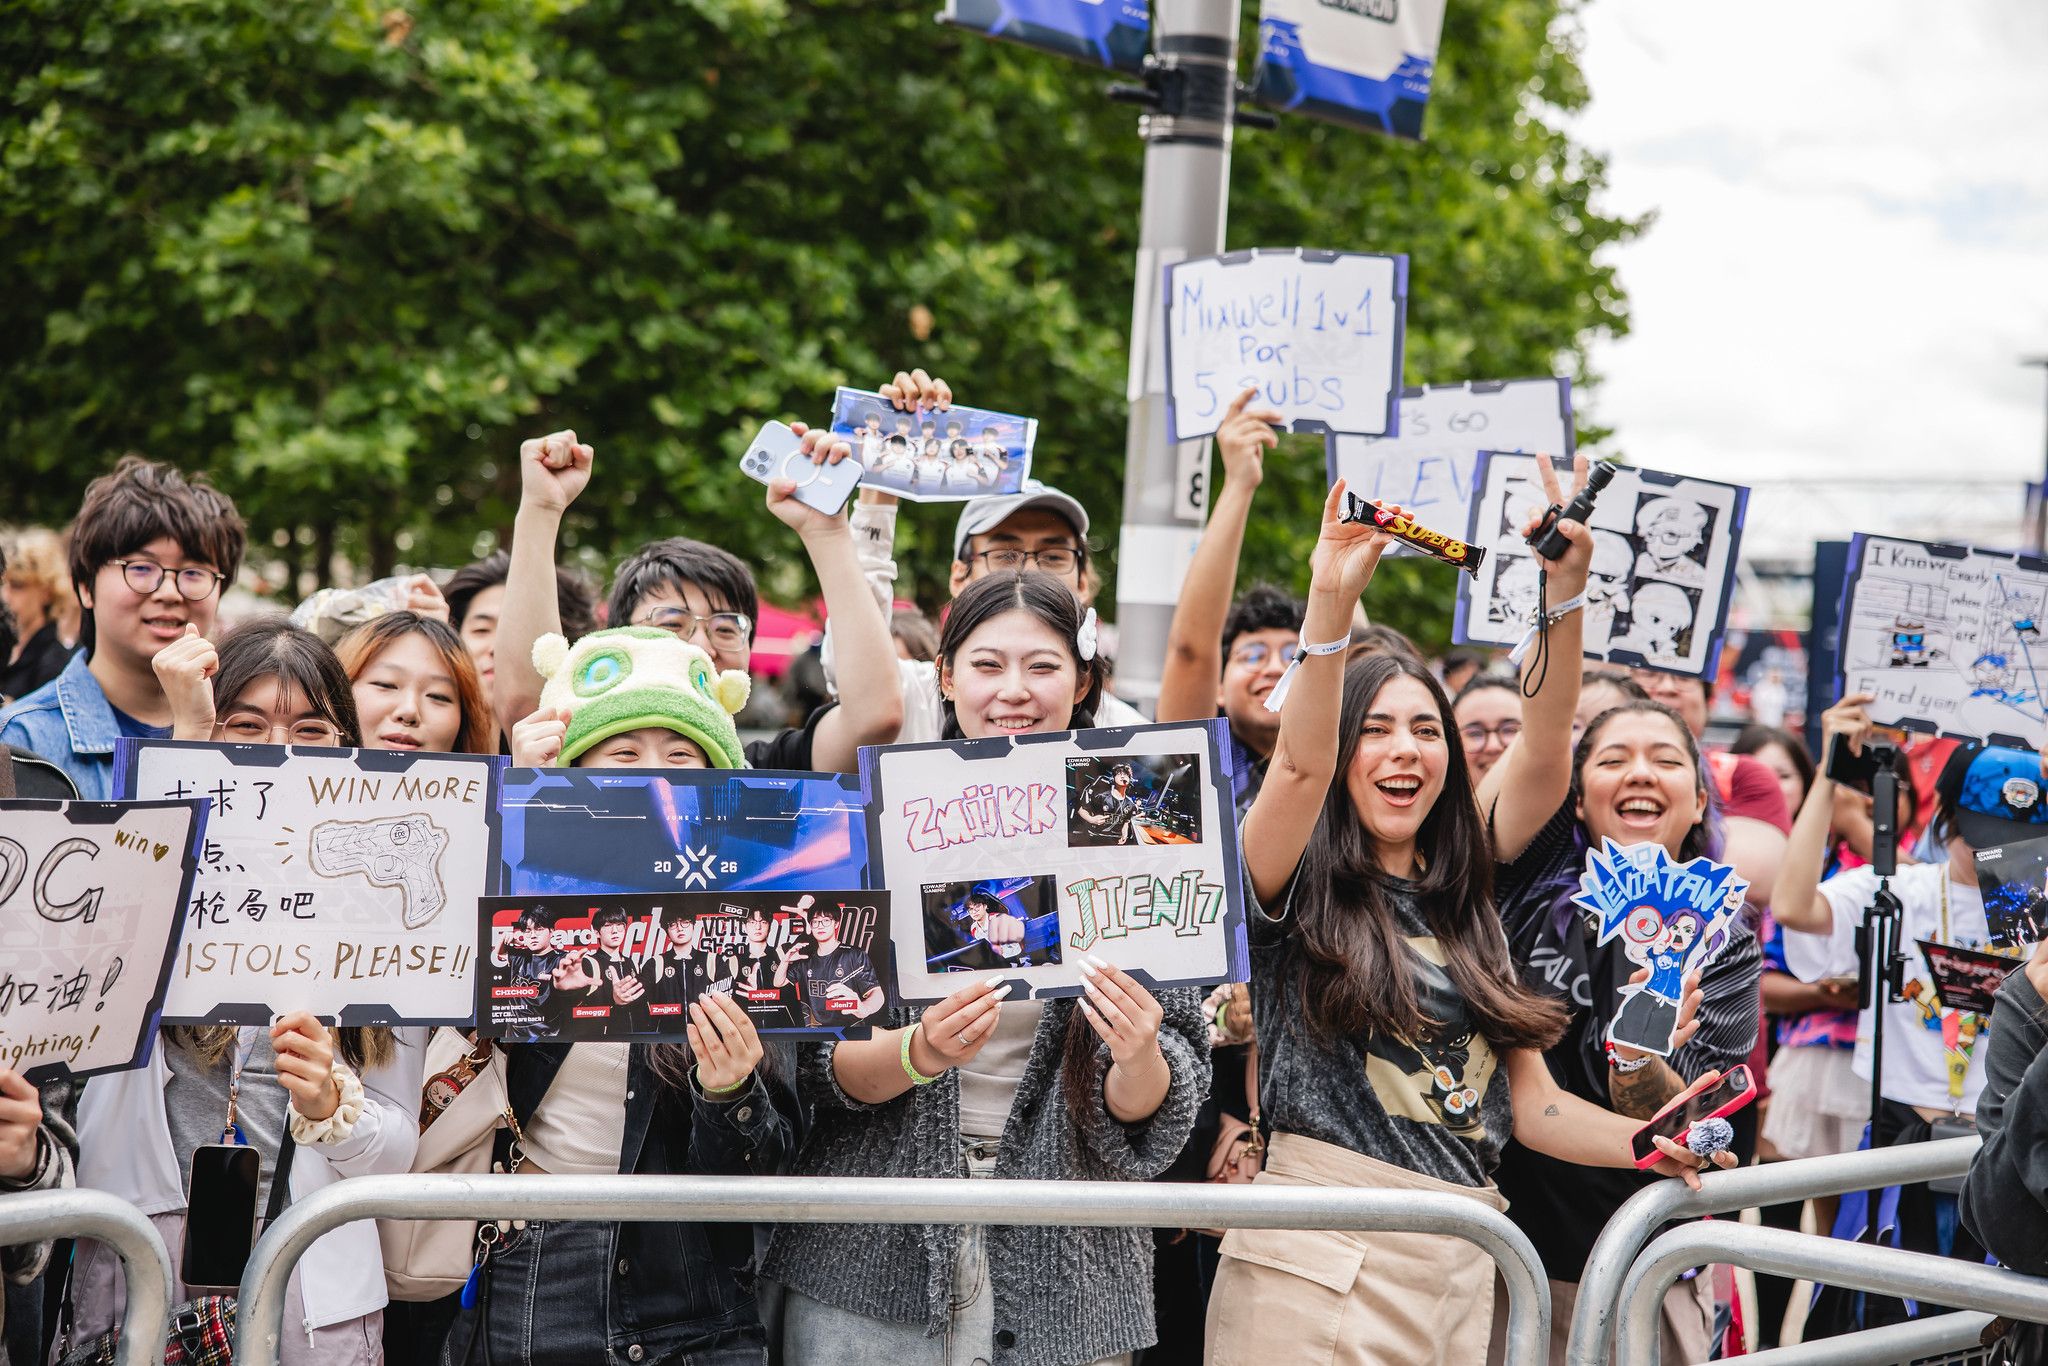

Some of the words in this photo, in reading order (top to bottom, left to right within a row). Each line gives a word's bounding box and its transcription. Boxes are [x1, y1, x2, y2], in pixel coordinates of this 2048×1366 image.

[1195, 371, 1217, 417] 5
[1384, 516, 1448, 548] SUPER
[1444, 541, 1467, 559] 8
[1868, 544, 1884, 567] I
[1890, 548, 1946, 571] Know
[308, 776, 382, 808] WIN
[392, 776, 480, 803] MORE
[654, 861, 672, 873] 20
[720, 861, 738, 873] 26
[725, 906, 743, 915] EDG
[1066, 869, 1224, 951] JIENI7
[334, 941, 471, 980] PLEASE!!
[495, 988, 535, 996] CHICHOO
[751, 991, 777, 1000] nobody
[576, 1008, 607, 1018] Smoggy
